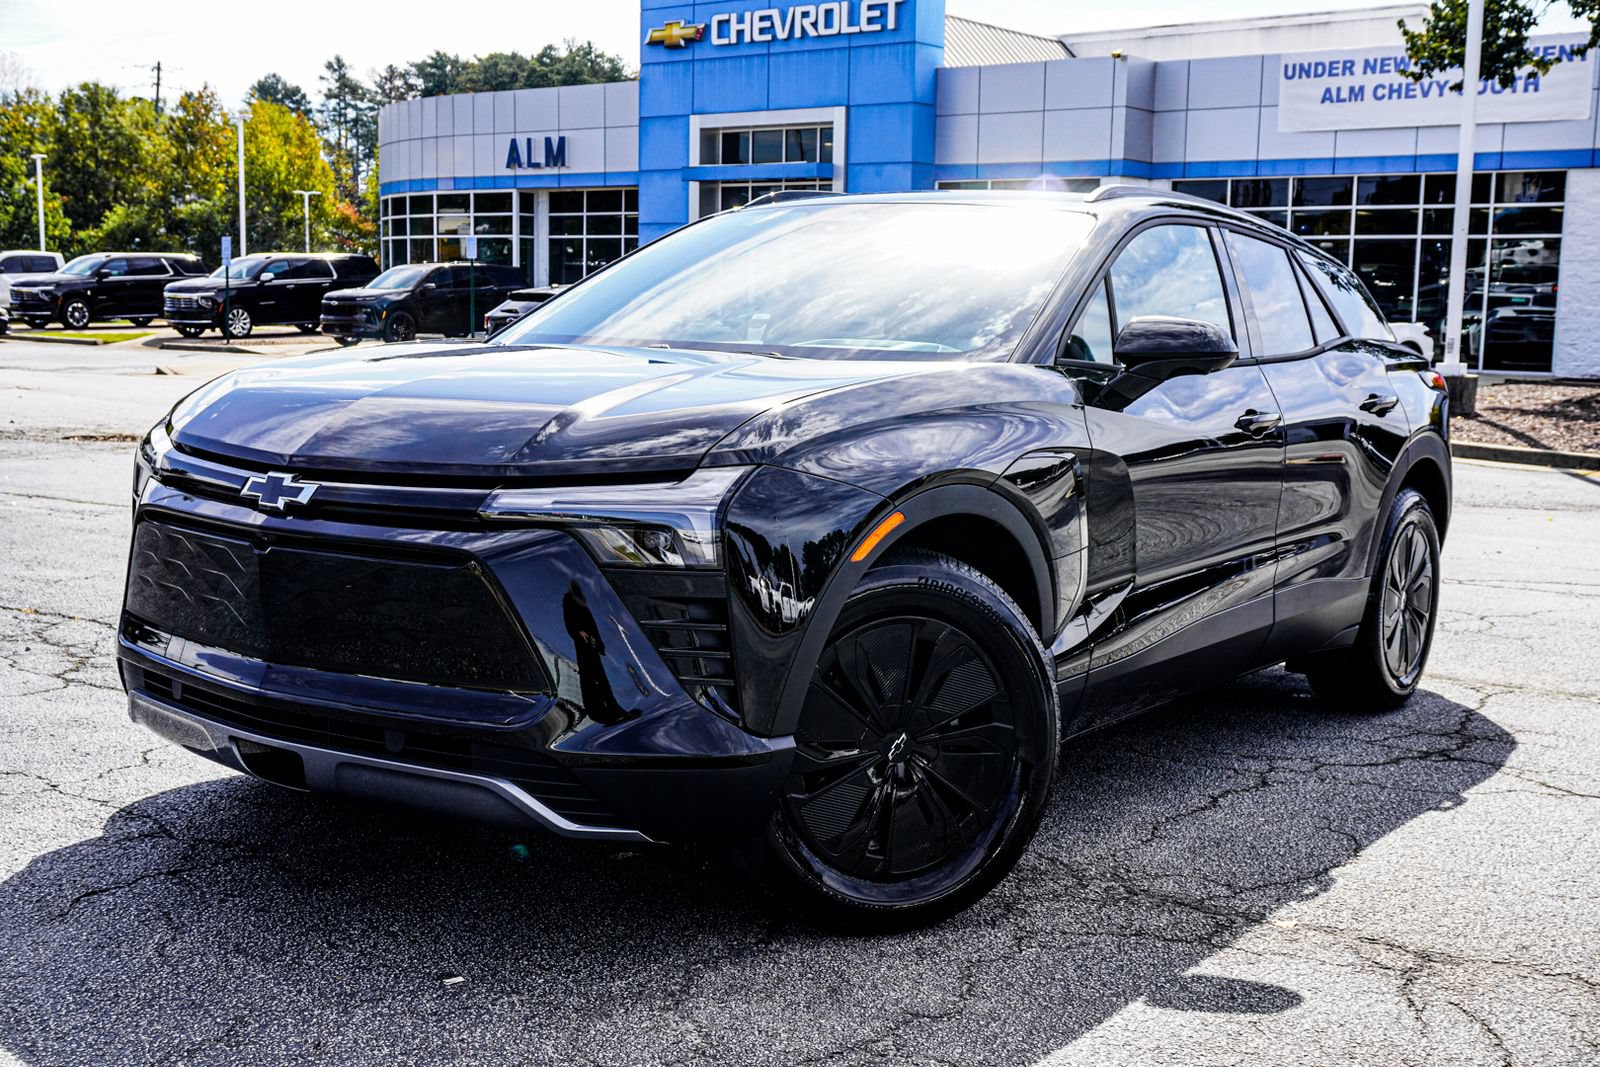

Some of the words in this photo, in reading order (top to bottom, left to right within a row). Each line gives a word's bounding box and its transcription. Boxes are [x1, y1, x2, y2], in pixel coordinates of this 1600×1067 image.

[711, 0, 903, 45] CHEVROLET
[1283, 59, 1355, 80] UNDER
[1362, 56, 1411, 76] NEW
[1320, 86, 1365, 104] ALM
[1372, 80, 1449, 101] CHEVY
[1457, 75, 1540, 96] OUTH
[505, 135, 567, 169] ALM
